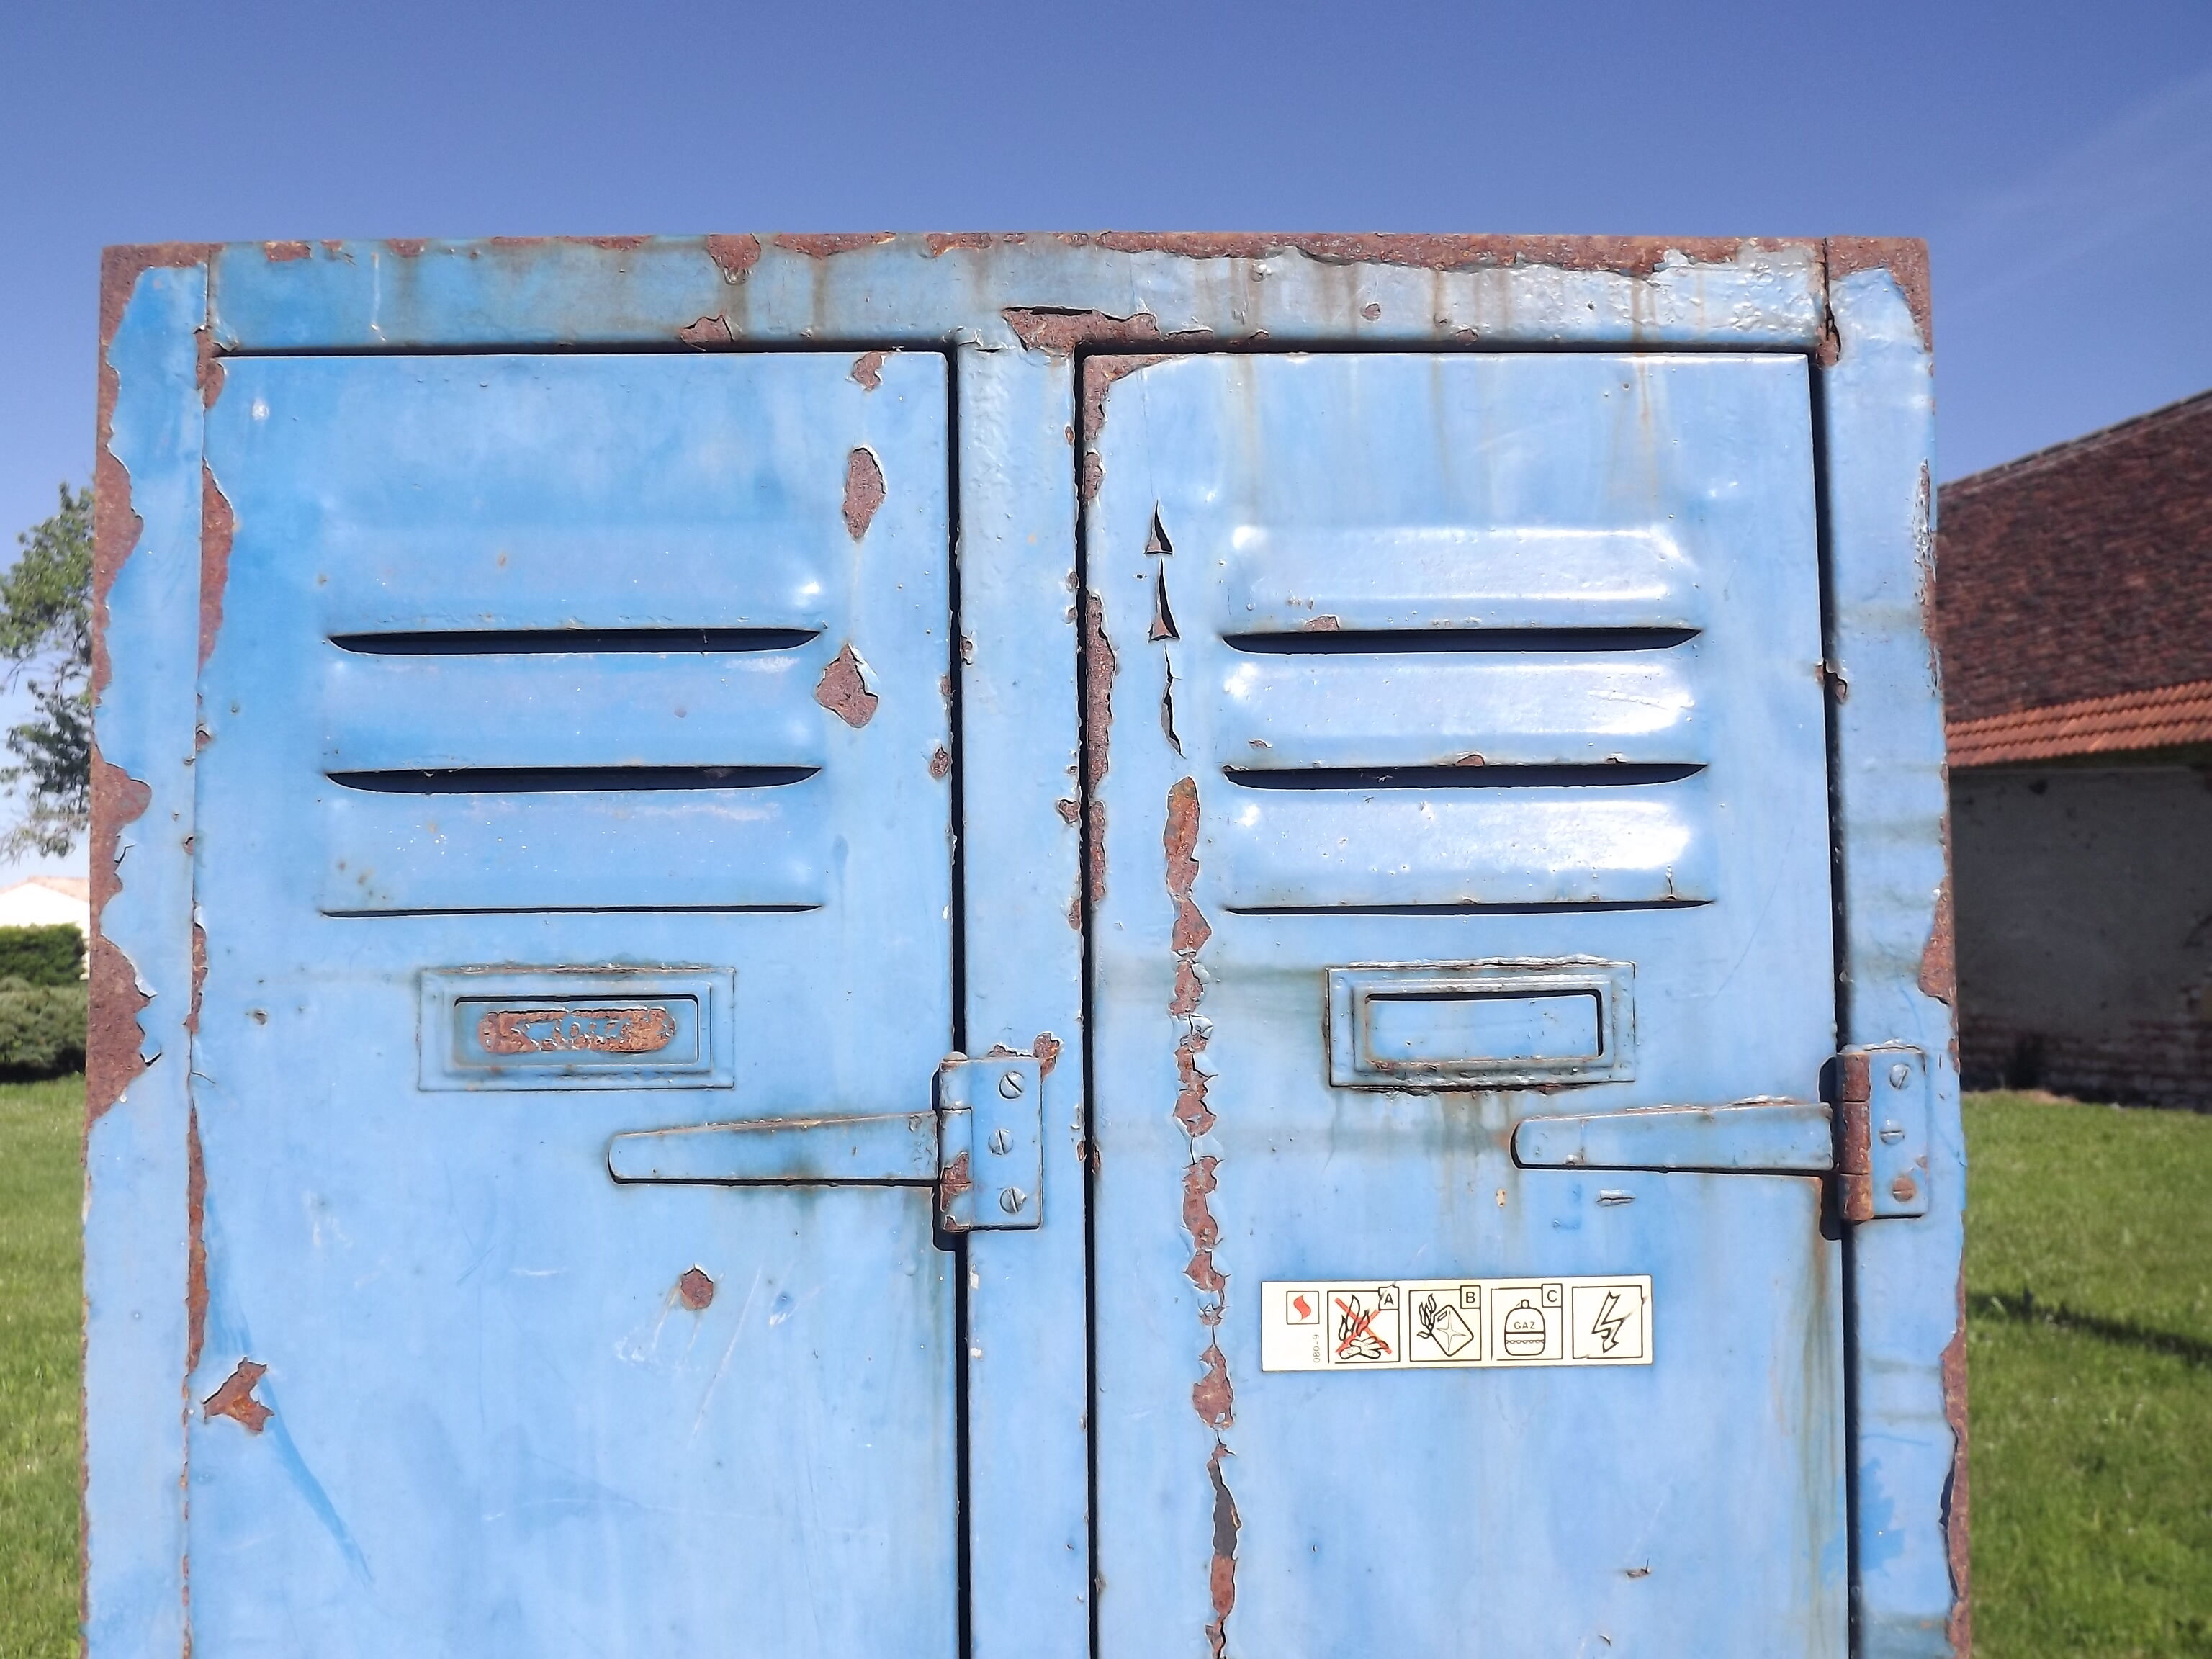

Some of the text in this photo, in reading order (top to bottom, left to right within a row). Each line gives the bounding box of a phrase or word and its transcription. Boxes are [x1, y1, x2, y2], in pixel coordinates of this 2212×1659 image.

[1384, 1293, 1395, 1305] A
[1466, 1291, 1477, 1304] B
[1547, 1290, 1558, 1303] C
[1514, 1321, 1536, 1331] GAZ
